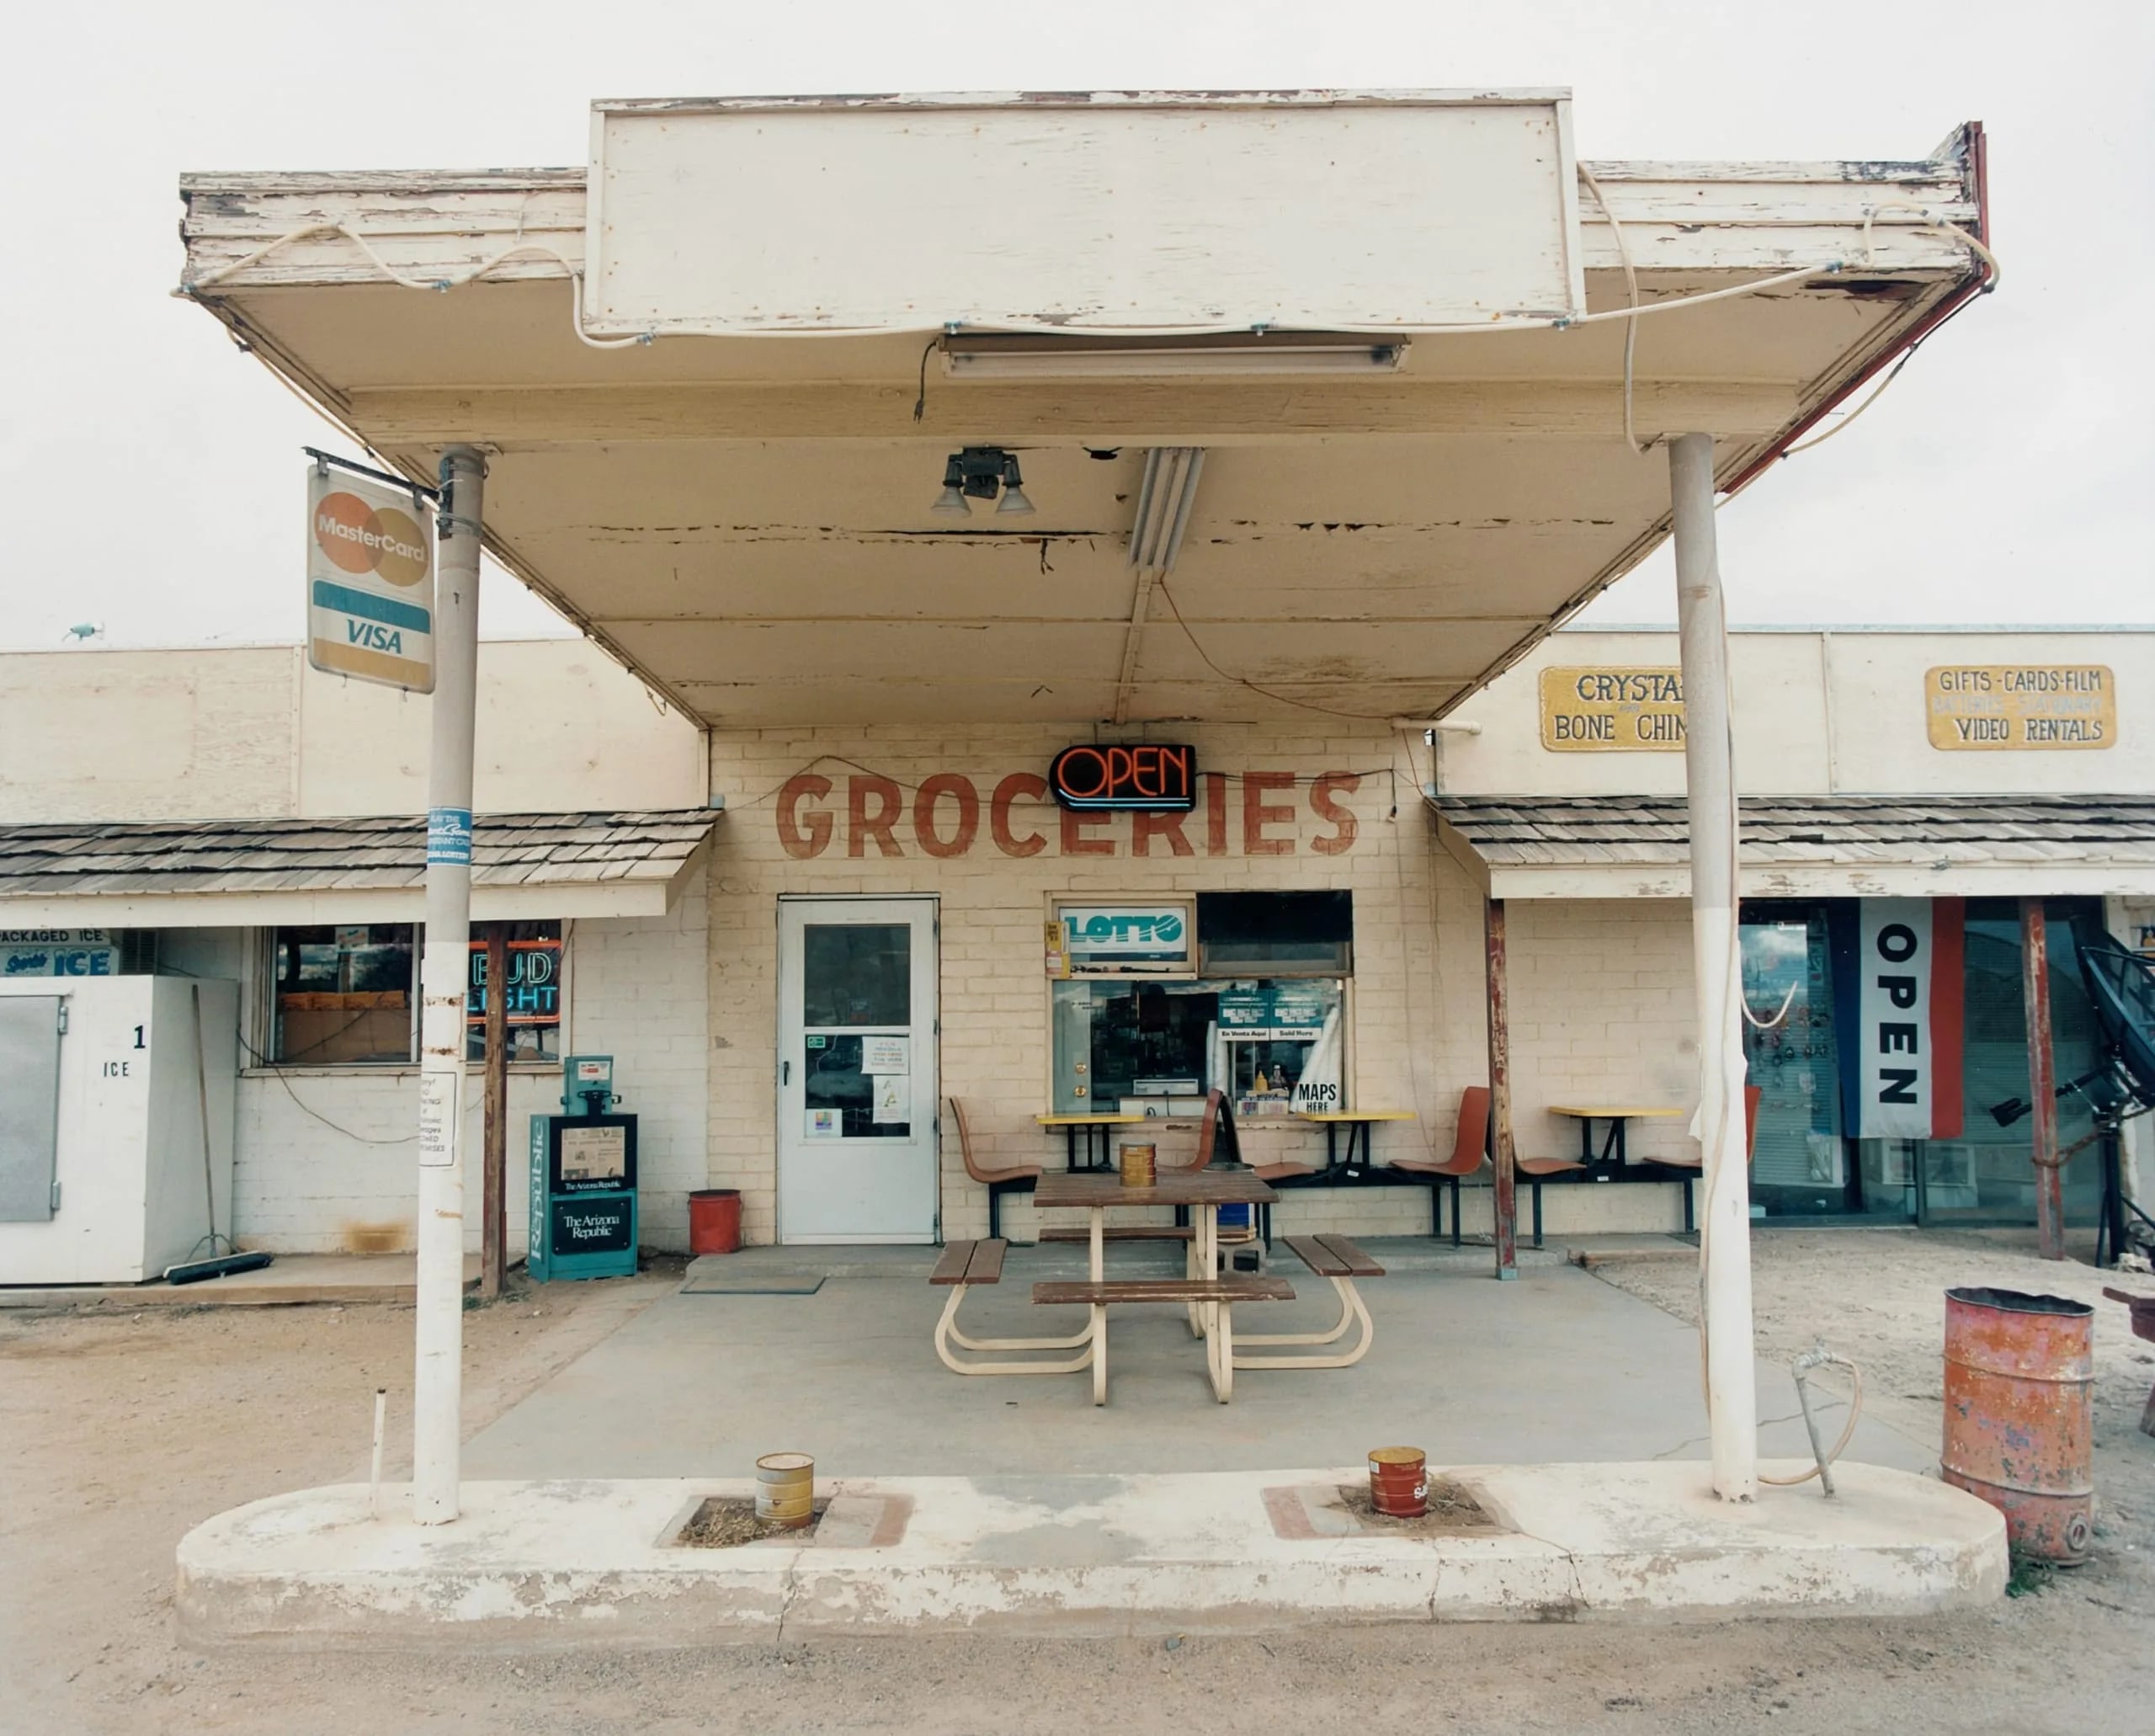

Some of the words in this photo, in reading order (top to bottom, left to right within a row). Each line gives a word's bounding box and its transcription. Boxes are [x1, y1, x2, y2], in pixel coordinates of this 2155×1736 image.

[317, 514, 425, 562] MasterCard
[346, 619, 403, 654] VISA
[1576, 674, 1684, 701] CRYSTA
[1555, 715, 1616, 740] BONE
[1636, 715, 1687, 741] CHIN
[1954, 718, 2010, 741] VIDEO
[2025, 718, 2103, 741] RENTALS
[1057, 747, 1187, 799] OPEN
[775, 770, 1363, 859] GROCERIES
[0, 930, 69, 942] ACKAGED
[79, 929, 104, 942] ICE
[1064, 914, 1183, 943] LOTTO
[54, 948, 110, 977] ICE
[1876, 923, 1918, 1105] OPEN
[134, 1025, 146, 1049] 1
[104, 1062, 130, 1078] ICE
[1299, 1083, 1337, 1101] MAPS
[1306, 1101, 1329, 1112] HERE
[531, 1121, 544, 1261] Republic
[563, 1216, 582, 1227] The
[583, 1214, 620, 1226] Arizona
[572, 1225, 612, 1239] Republic
